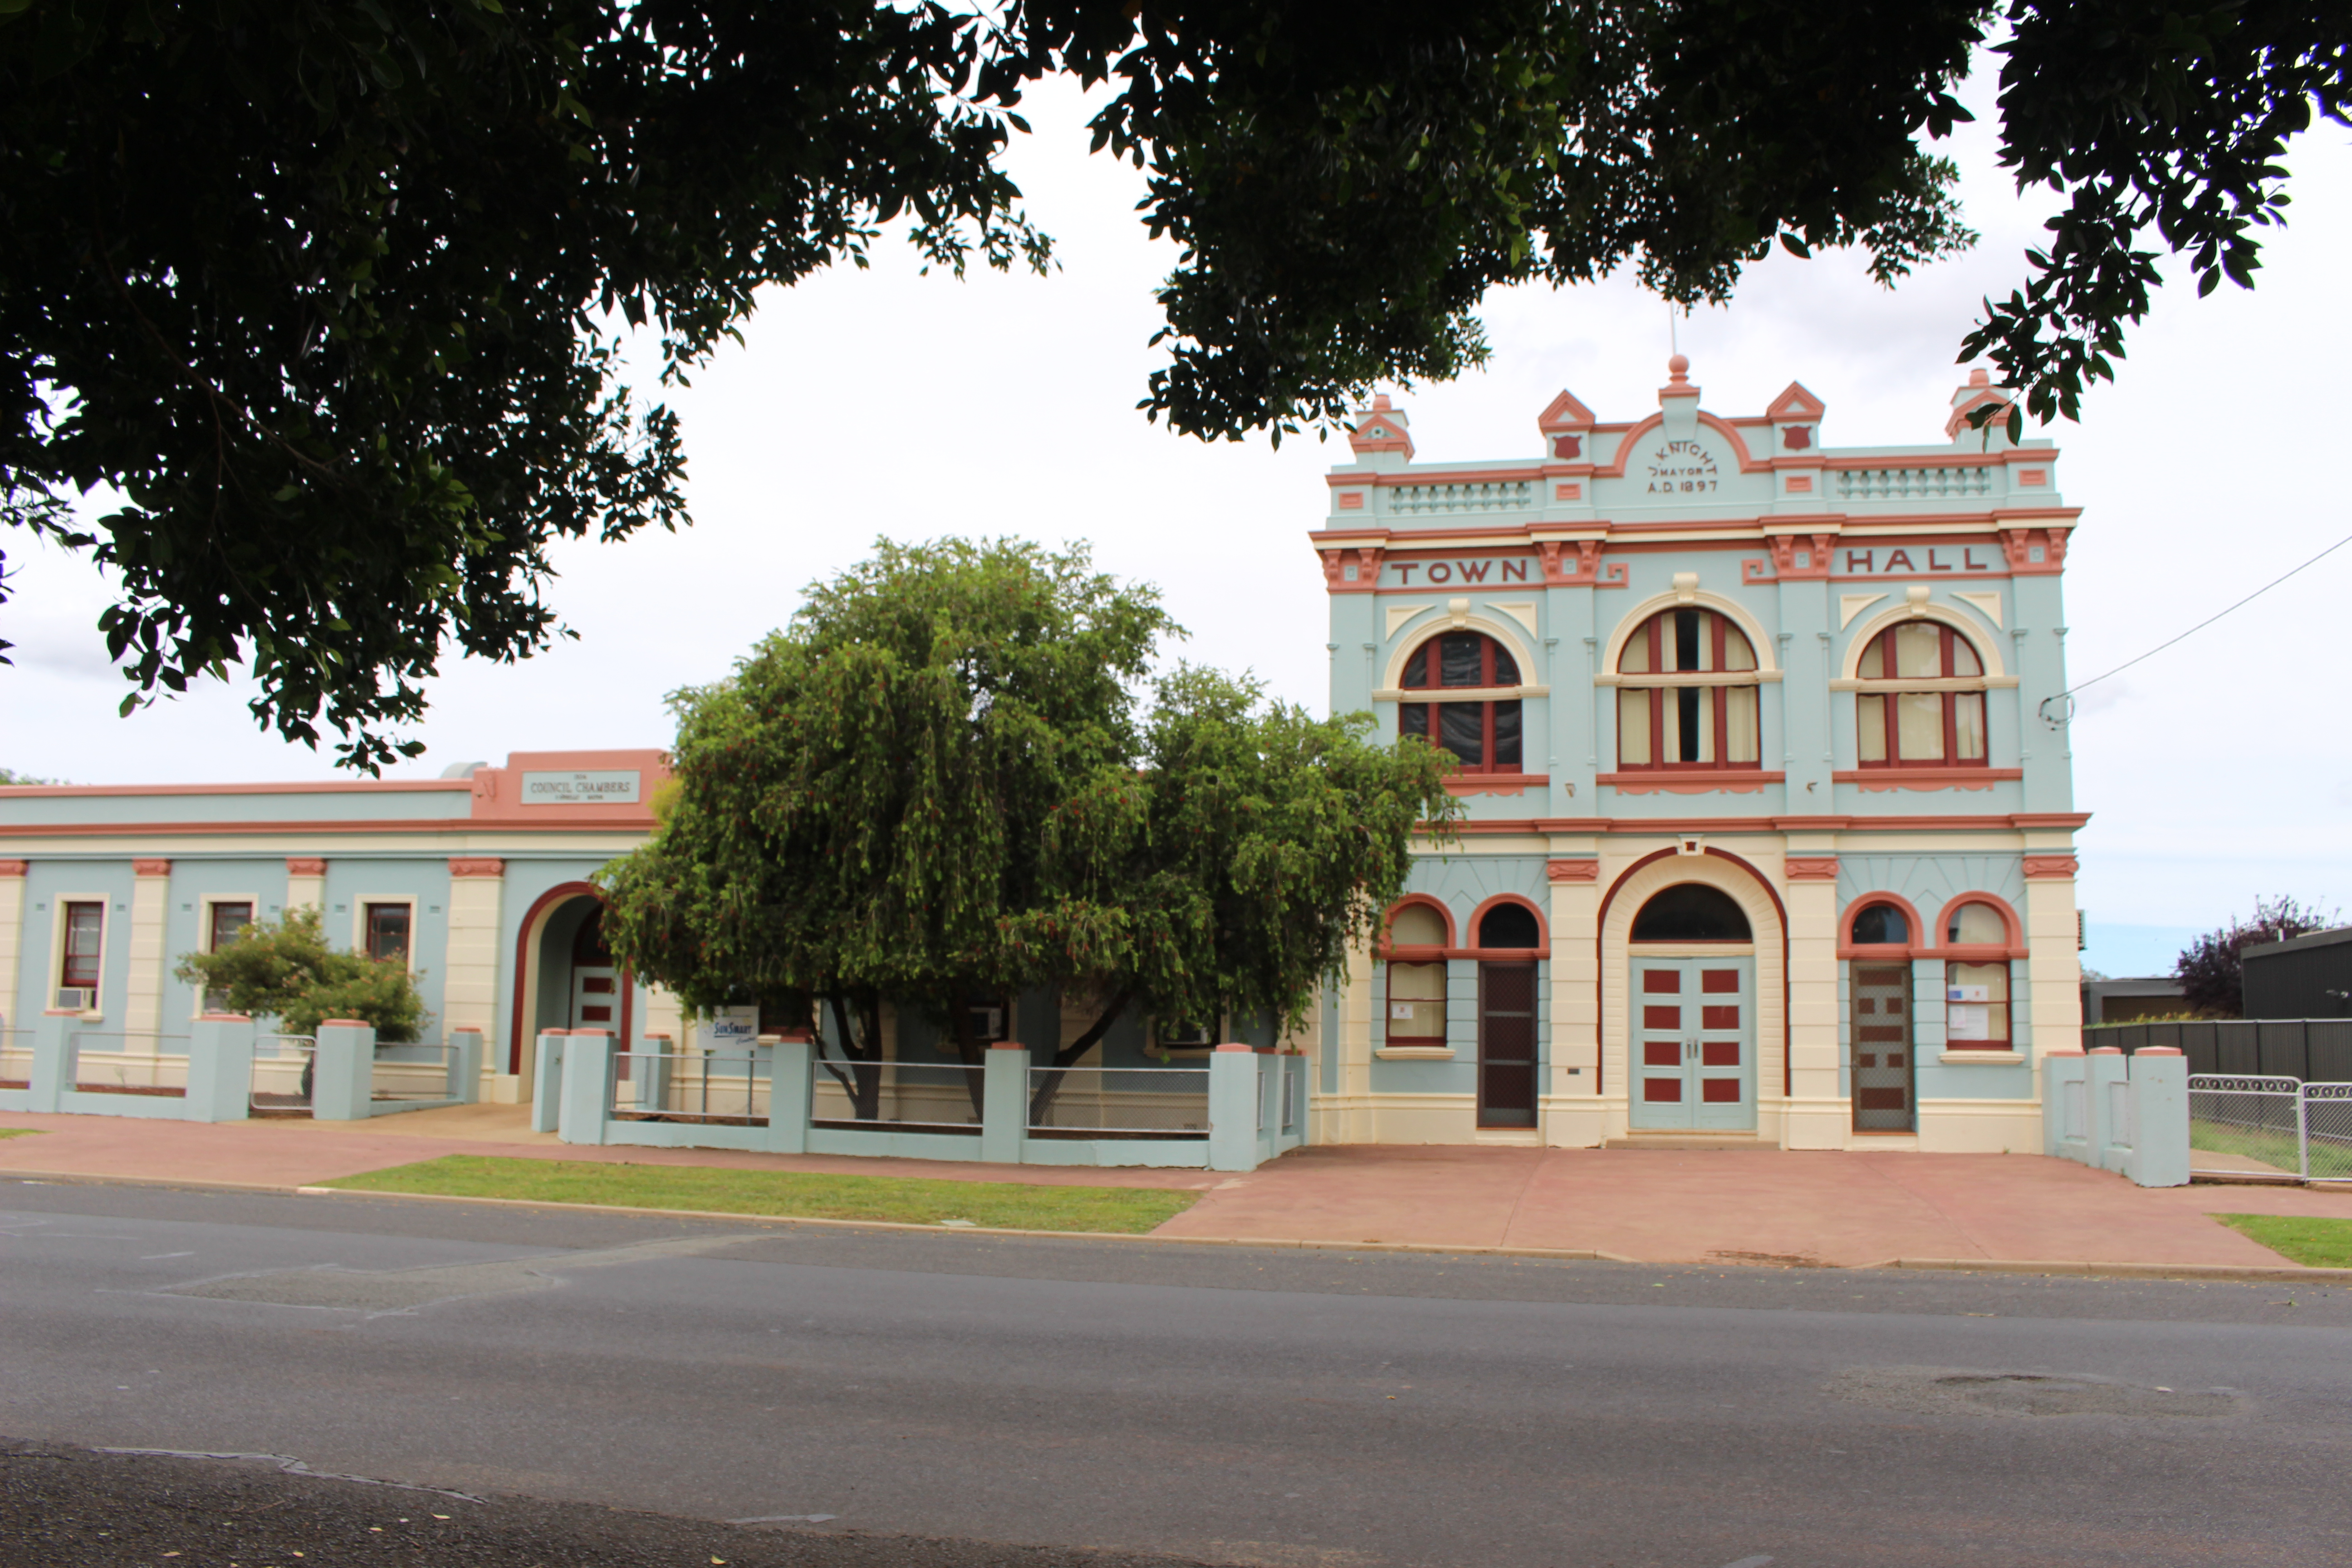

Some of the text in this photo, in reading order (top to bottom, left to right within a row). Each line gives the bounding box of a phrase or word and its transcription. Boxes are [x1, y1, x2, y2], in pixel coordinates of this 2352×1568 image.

[1656, 441, 1717, 474] KNIGHT
[1661, 468, 1702, 476] MAYOR
[1680, 480, 1718, 492] 1897
[1391, 548, 1988, 585] TOWN HALL
[530, 782, 631, 794] COUNCIL CHAMBERS
